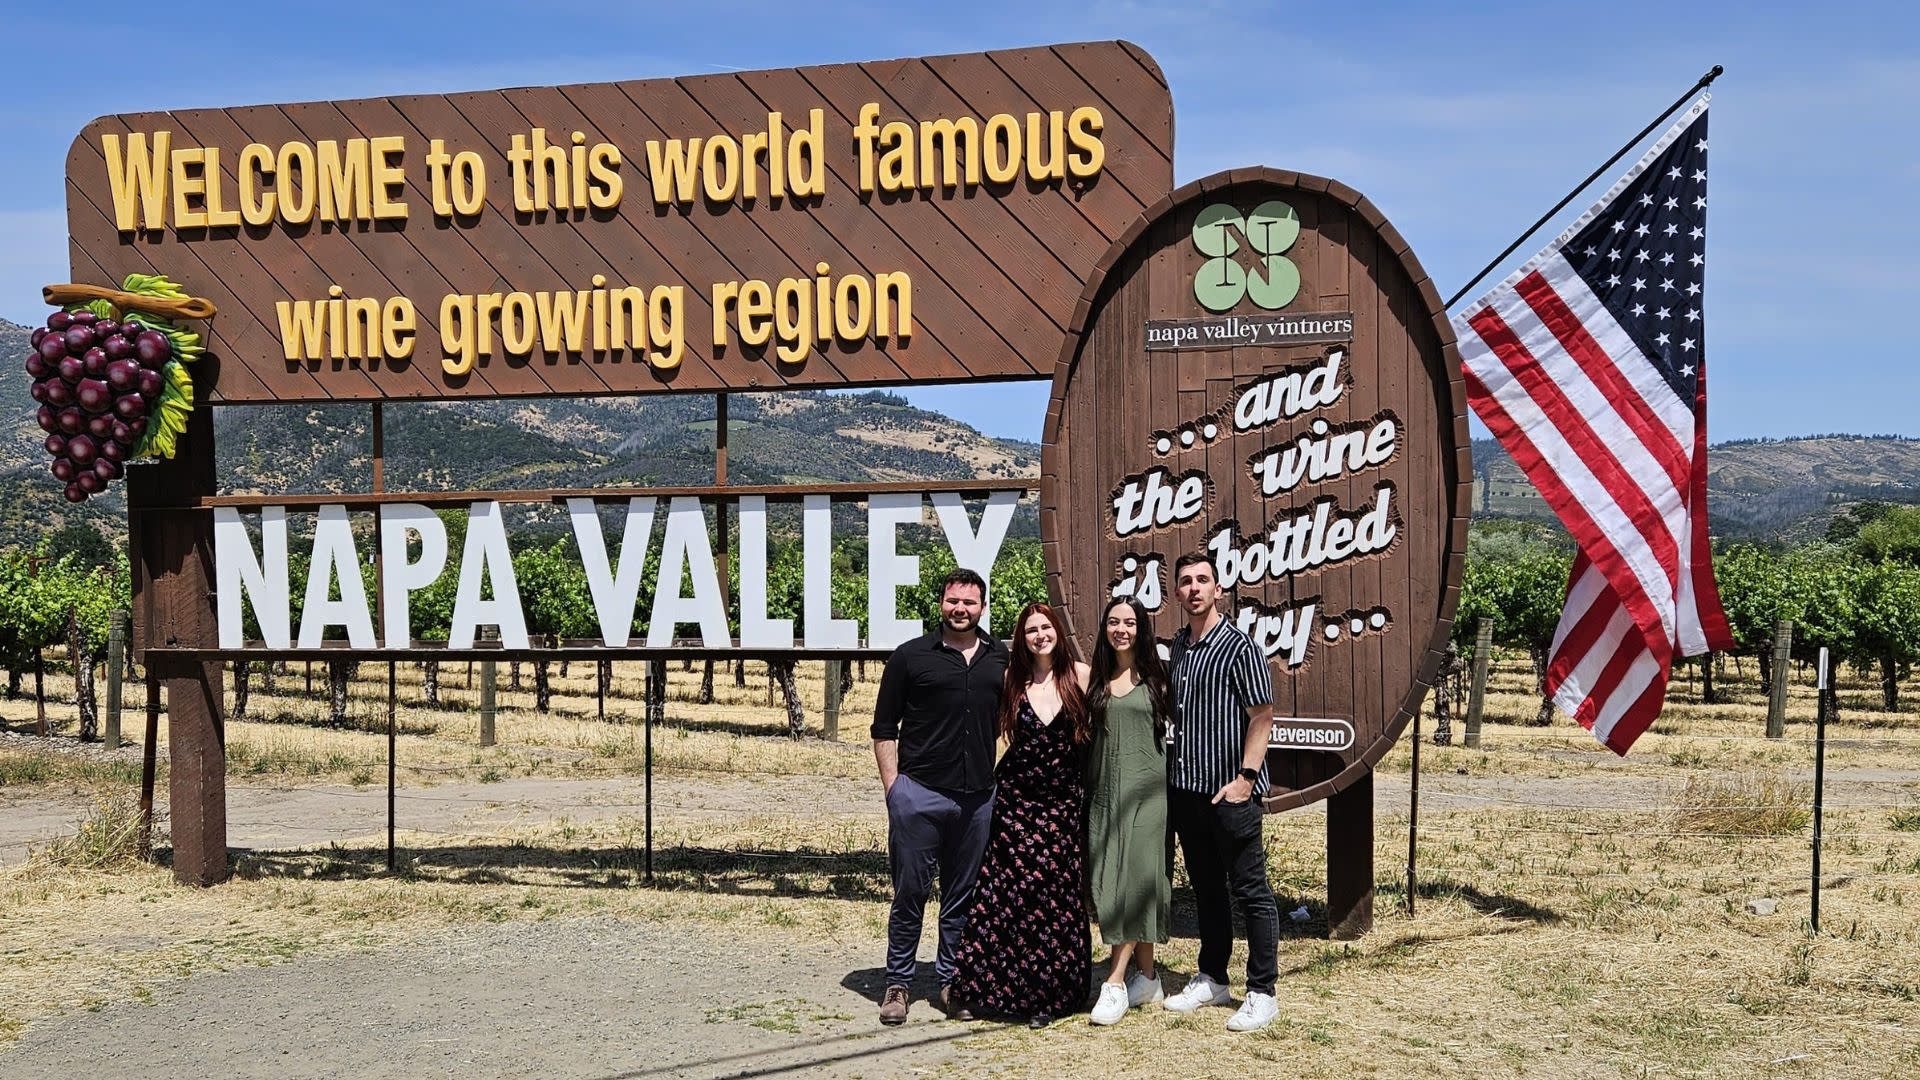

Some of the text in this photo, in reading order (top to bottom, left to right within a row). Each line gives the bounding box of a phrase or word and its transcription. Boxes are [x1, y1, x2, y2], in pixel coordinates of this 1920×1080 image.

[101, 102, 1105, 231] WELCOME to this world famous
[275, 261, 913, 376] wine growing region
[1148, 316, 1353, 347] napa valley vintners
[1234, 351, 1344, 430] and
[1113, 419, 1396, 535] the wine
[213, 490, 1022, 650] NAPA VALLEY
[1207, 488, 1397, 589] bottled
[1267, 723, 1345, 745] tevenson
